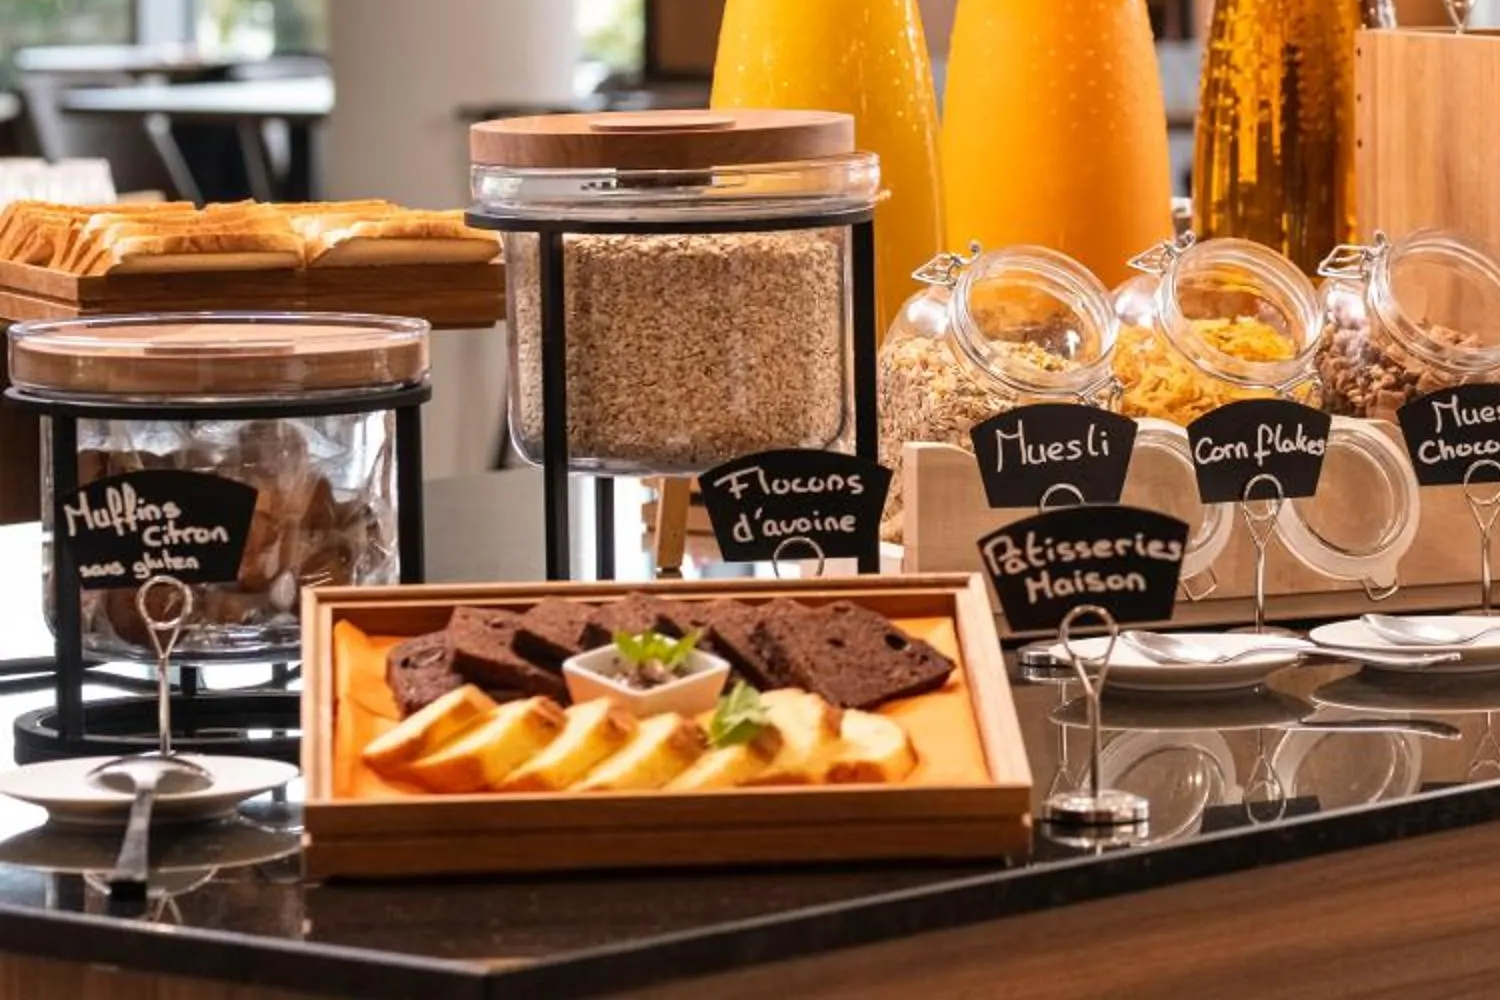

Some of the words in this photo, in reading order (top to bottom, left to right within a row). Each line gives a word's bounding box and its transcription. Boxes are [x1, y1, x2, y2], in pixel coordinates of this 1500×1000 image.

[995, 420, 1109, 473] Muesli
[1195, 437, 1249, 465] Corn
[713, 466, 864, 499] Flocons
[63, 481, 182, 536] Muffins
[733, 507, 856, 542] d'avoine
[79, 561, 126, 578] sans
[132, 550, 200, 579] gluten
[1025, 570, 1146, 604] Maison
